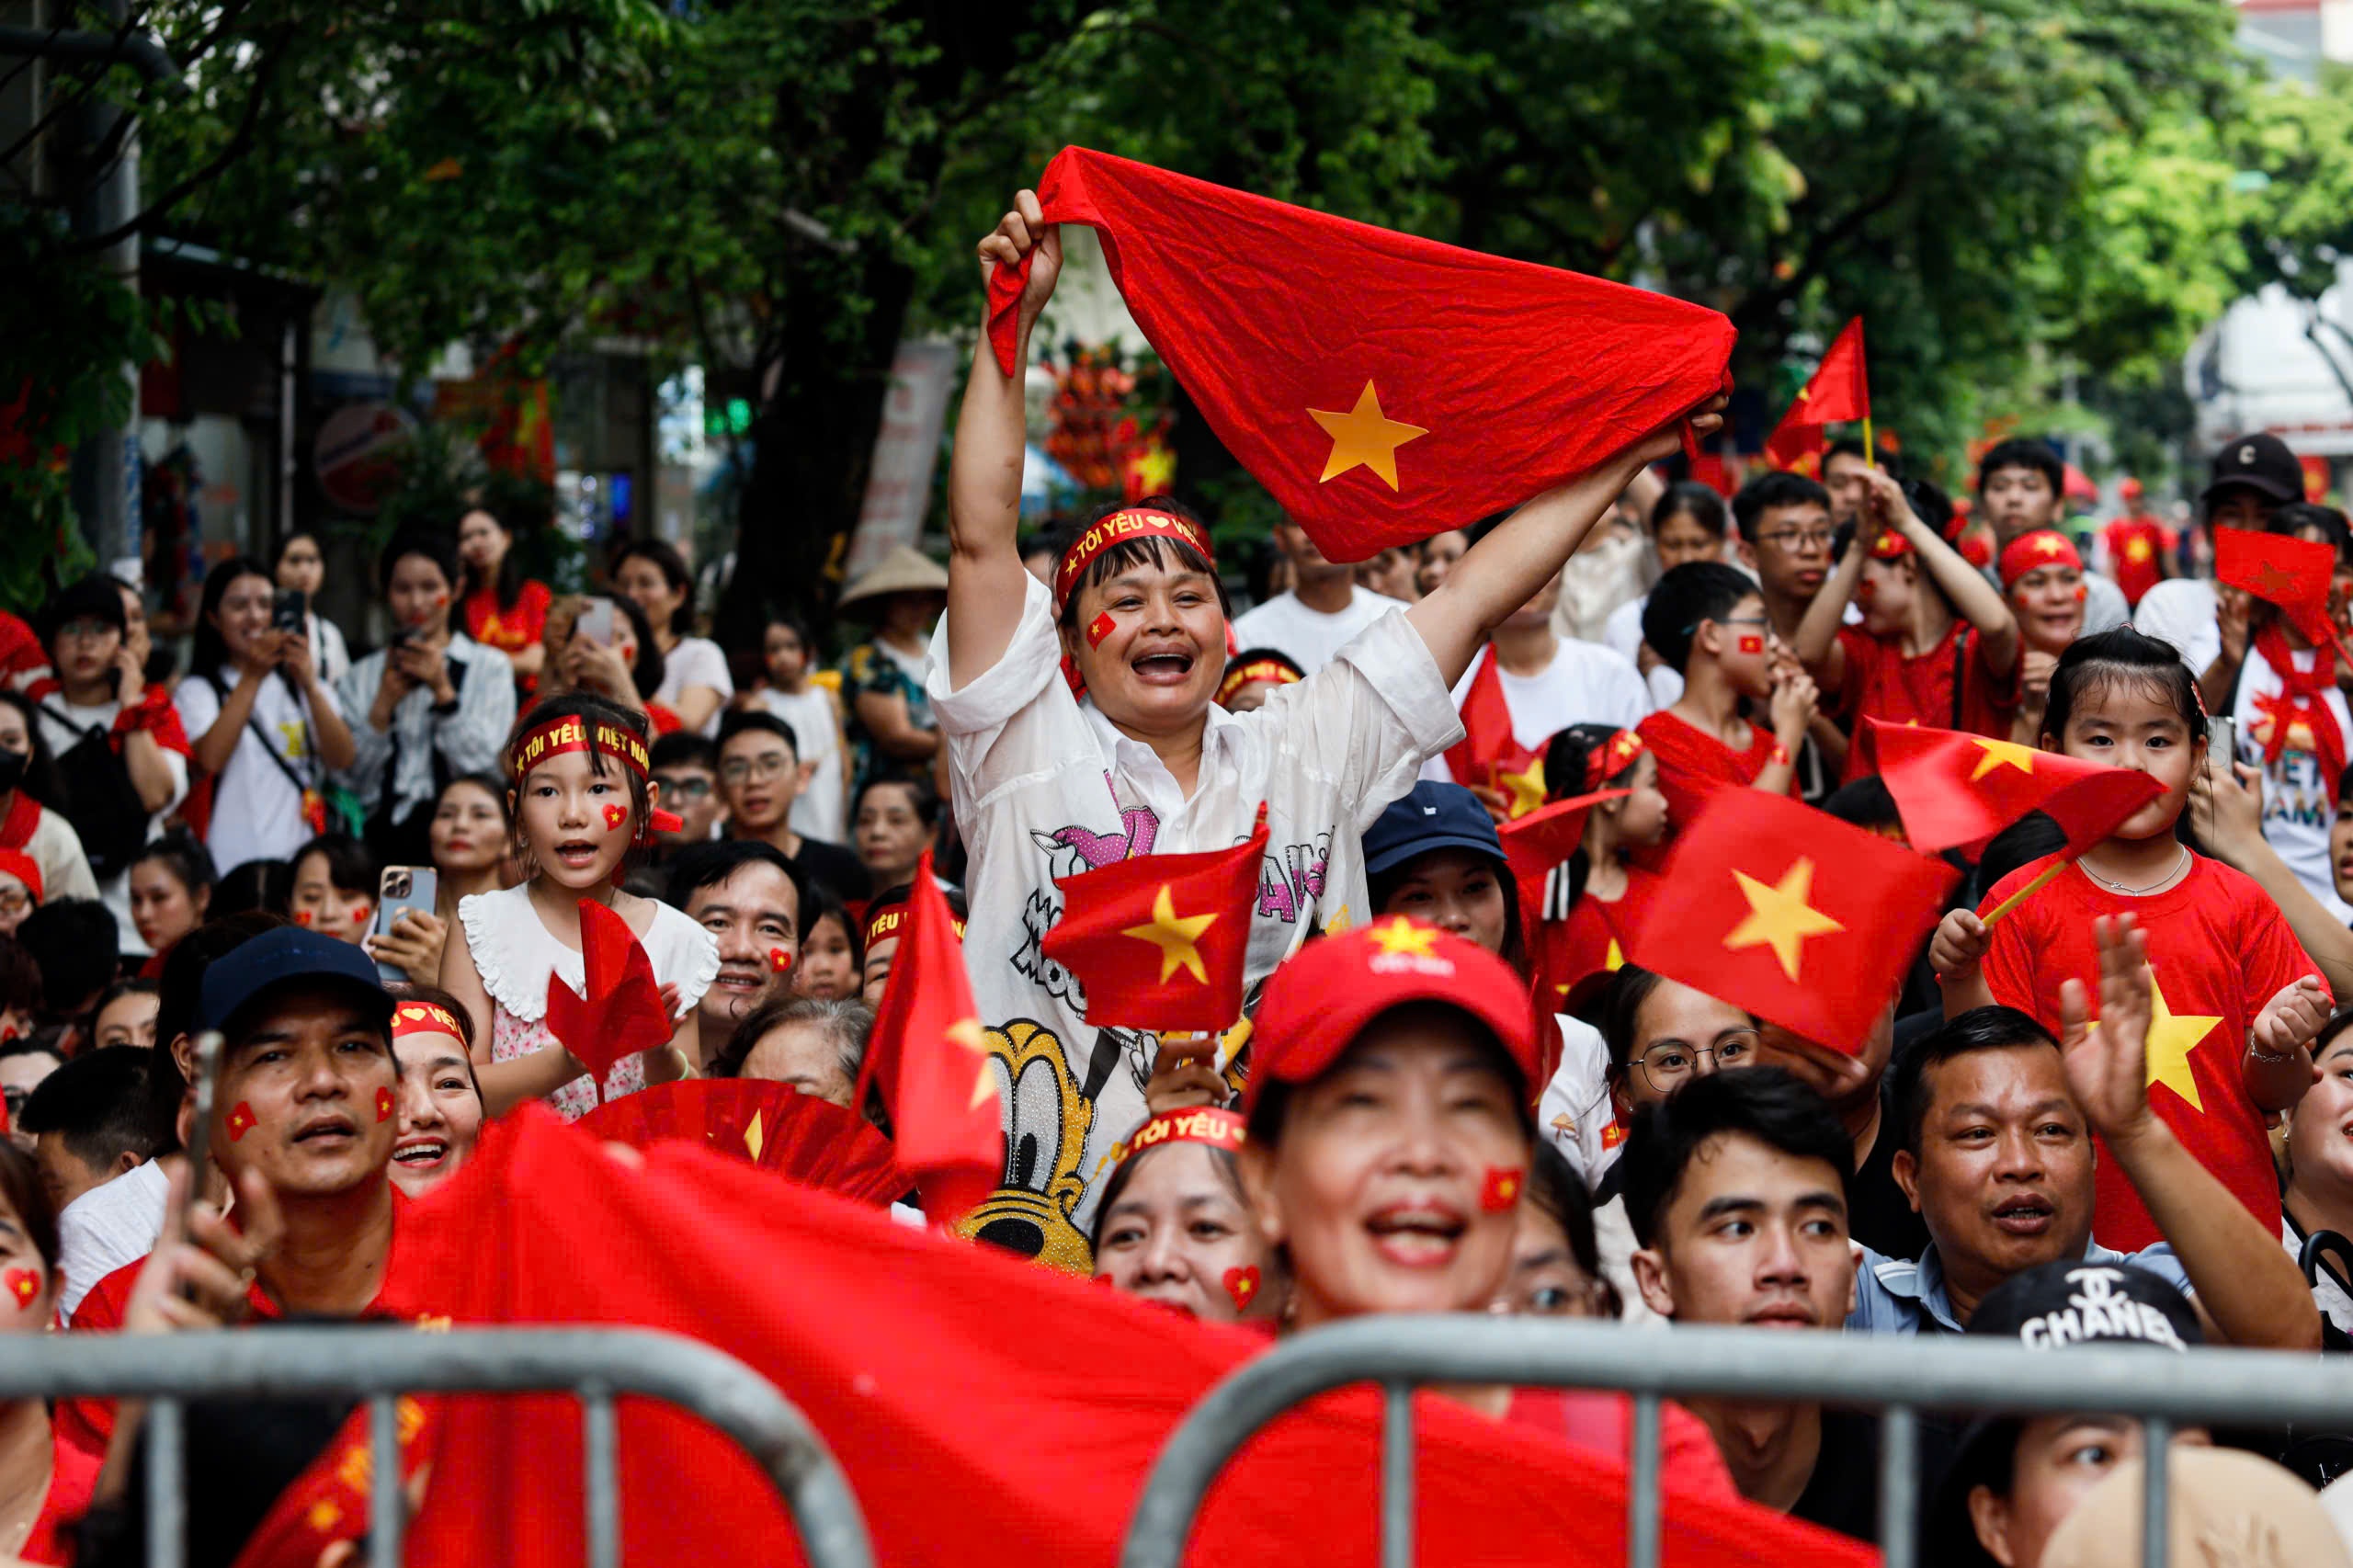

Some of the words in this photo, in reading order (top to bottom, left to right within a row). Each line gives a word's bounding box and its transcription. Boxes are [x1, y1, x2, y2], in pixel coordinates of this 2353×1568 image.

[1077, 528, 1103, 560] TÔI
[1103, 513, 1144, 537] YÊU
[525, 735, 544, 763] TÔI
[549, 723, 586, 747] YÊU
[631, 740, 650, 772] NA
[871, 912, 899, 937] YÊU
[1134, 1119, 1170, 1149] TÔI
[1175, 1112, 1228, 1140] YÊU
